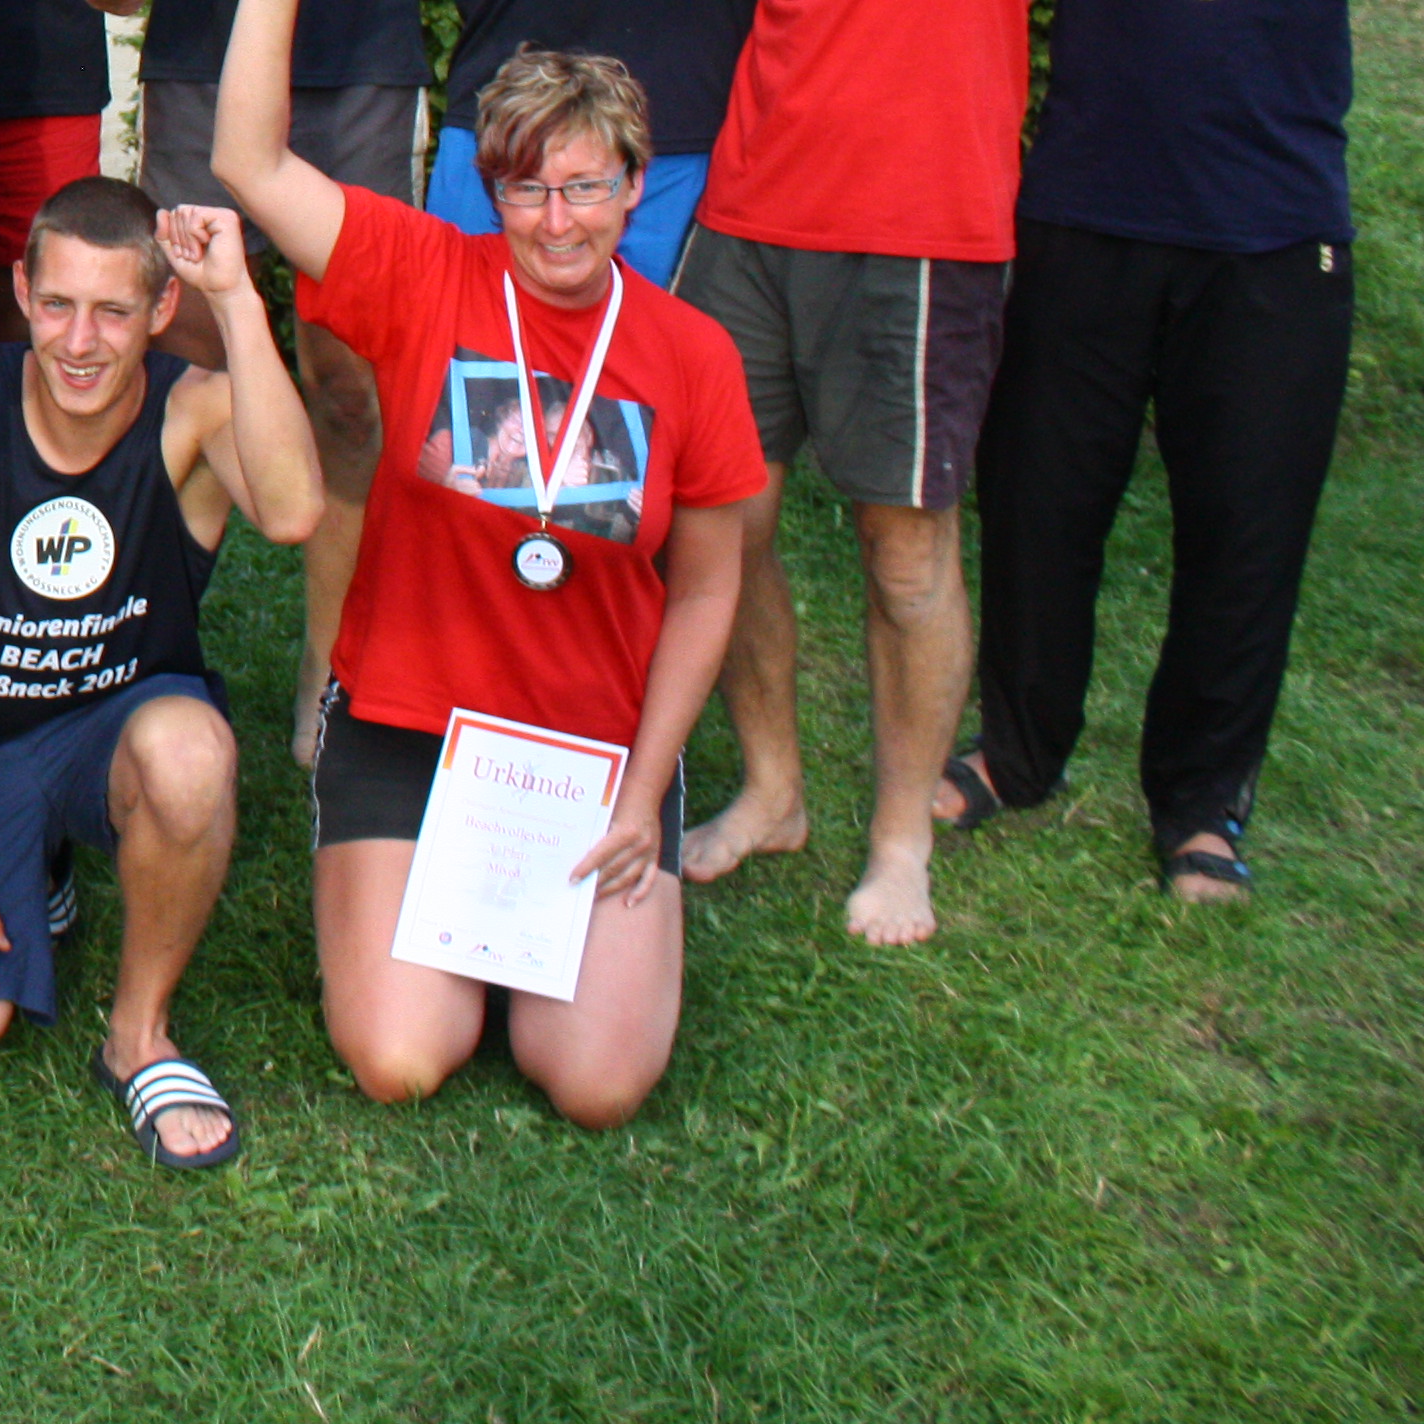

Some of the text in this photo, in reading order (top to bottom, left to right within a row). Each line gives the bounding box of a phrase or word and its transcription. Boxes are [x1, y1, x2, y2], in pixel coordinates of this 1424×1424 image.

[16, 500, 112, 568] WOHNUNGSGENOSSENSCHAFT
[35, 535, 92, 564] WP
[0, 642, 105, 671] BEACH
[78, 657, 139, 693] 2013
[473, 754, 586, 803] Urkunde
